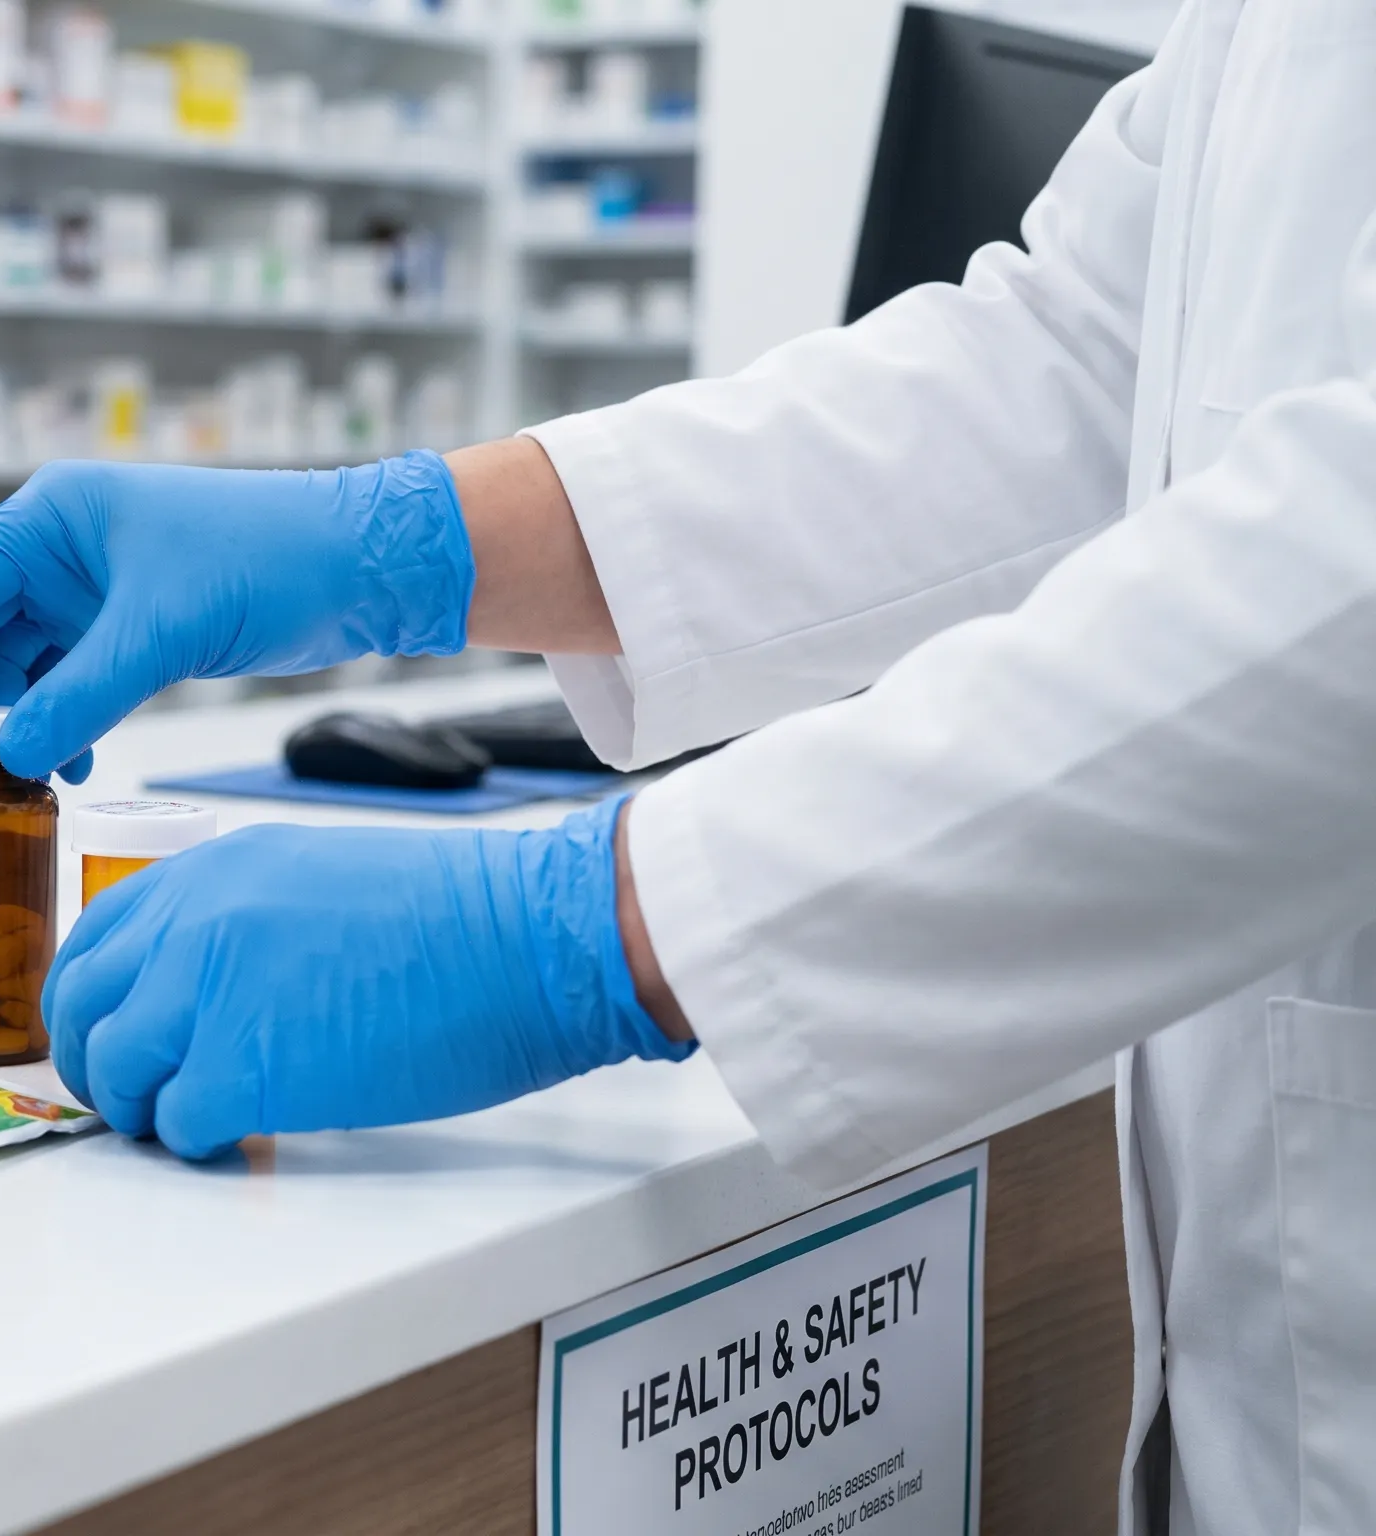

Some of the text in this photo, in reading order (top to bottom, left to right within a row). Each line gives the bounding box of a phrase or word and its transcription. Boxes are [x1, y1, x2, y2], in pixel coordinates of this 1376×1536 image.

[621, 1257, 927, 1449] HEALTH & SAFETY
[674, 1357, 881, 1511] PROTOCOLS
